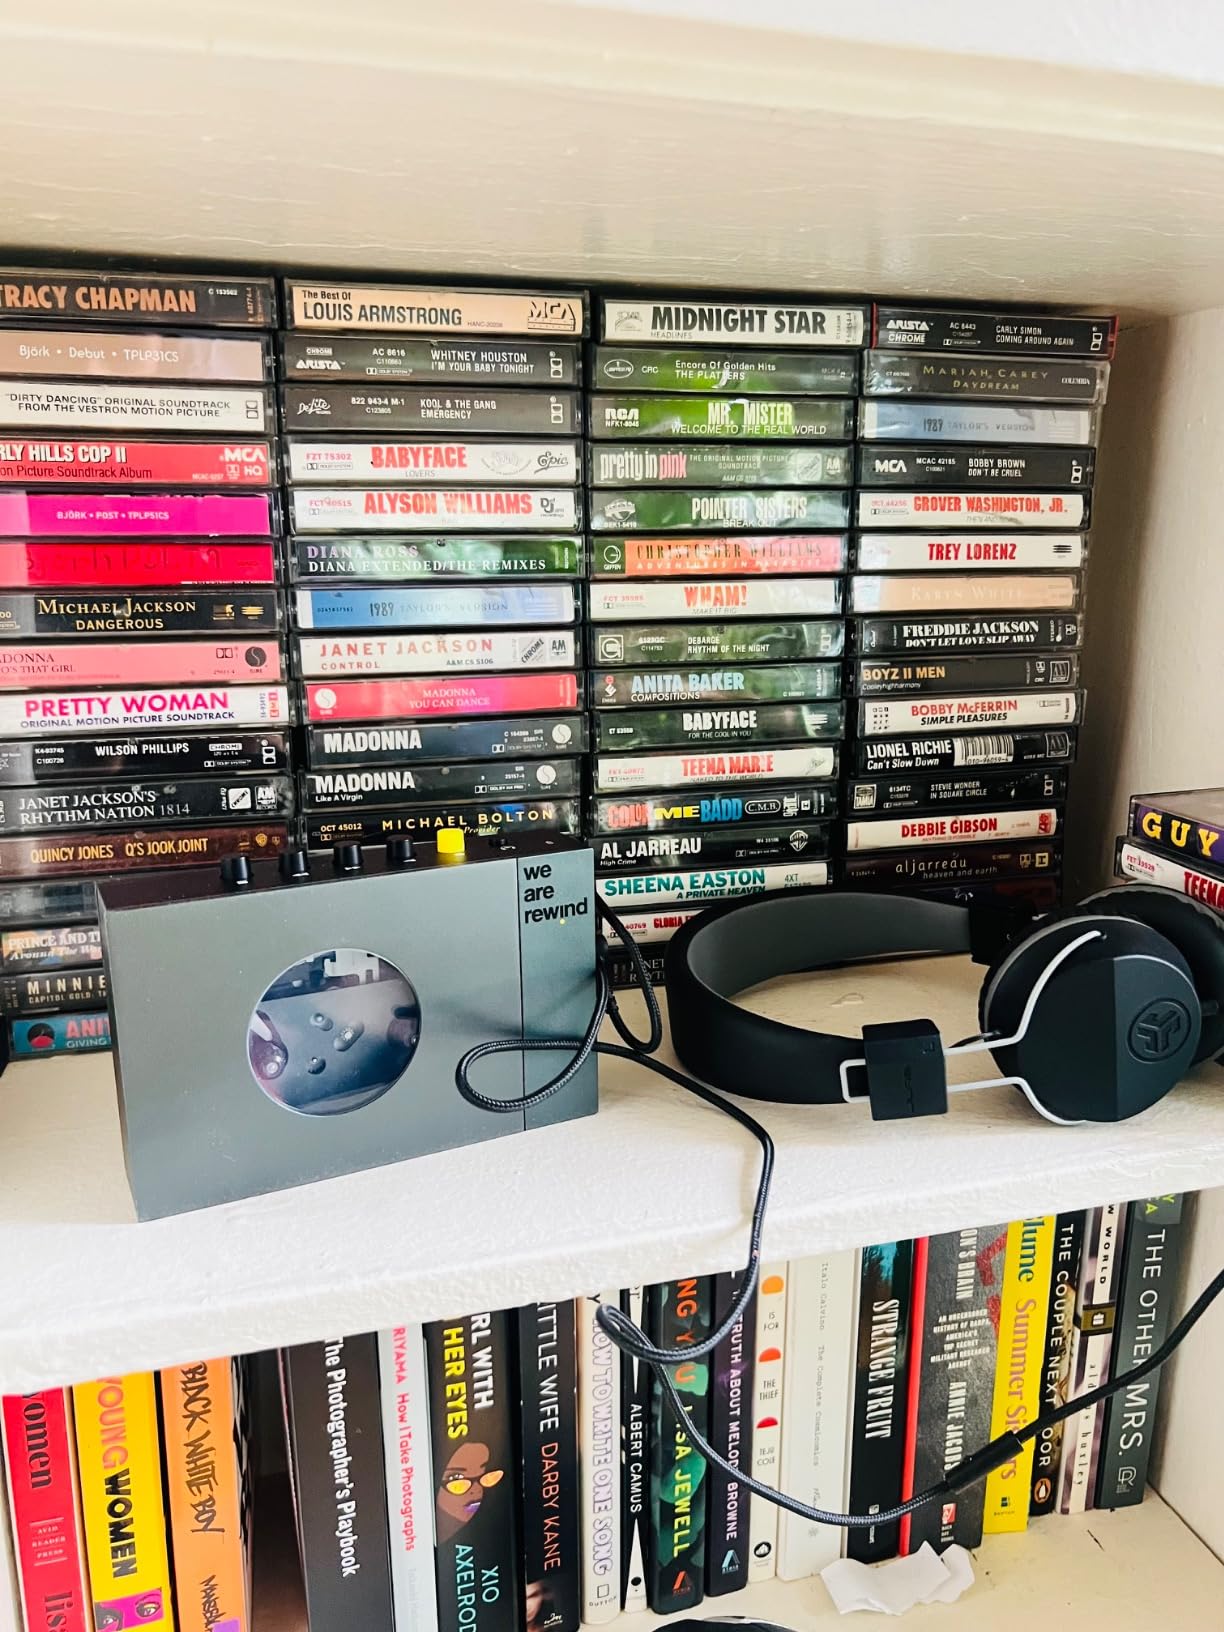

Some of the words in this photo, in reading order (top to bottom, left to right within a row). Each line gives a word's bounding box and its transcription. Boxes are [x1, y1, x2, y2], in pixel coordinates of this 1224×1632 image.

[75, 286, 196, 312] CHAPMAN
[303, 290, 317, 299] The
[321, 291, 339, 300] Best
[341, 292, 351, 300] Of
[303, 302, 353, 321] LOUIS
[358, 305, 462, 326] ARMSTRONG
[651, 306, 768, 333] MIDNIGHT
[774, 310, 826, 334] STAR
[996, 325, 1018, 334] CARLY
[1021, 326, 1042, 335] SIMON
[19, 344, 50, 358] Björk
[69, 347, 105, 359] Debut
[431, 350, 477, 361] WHITNEY
[481, 352, 527, 363] HOUSTON
[675, 360, 707, 369] Encore
[710, 361, 720, 370] Of
[723, 362, 755, 371] Golden
[758, 363, 776, 371] Hits
[923, 366, 988, 377] MARIAH
[998, 368, 1048, 379] CAREY
[953, 380, 1019, 390] DAYDREAM
[18, 403, 51, 412] FROM
[54, 404, 75, 413] THE
[78, 405, 128, 415] VESTRON
[131, 407, 173, 416] MOTION
[176, 408, 220, 417] PICTURE
[104, 396, 157, 407] ORIGINAL
[159, 399, 231, 409] SOUNDTRACK
[421, 409, 472, 420] EMERGENCY
[605, 408, 639, 420] RCA
[708, 402, 734, 425] MR.
[743, 402, 793, 426] MISTER
[224, 447, 266, 462] MCA
[371, 447, 468, 468] BABYFACE
[968, 458, 994, 468] BOBBY
[998, 459, 1025, 469] BROWN
[17, 465, 54, 478] Picture
[57, 465, 117, 479] Soundtrack
[119, 467, 152, 480] Album
[875, 459, 907, 473] MCA
[364, 492, 437, 514] ALYSON
[443, 492, 533, 514] WILLIAMS
[692, 498, 750, 520] POINTER
[755, 497, 807, 519] SISTERS
[913, 496, 961, 512] GROVER
[965, 497, 1045, 513] WASHINGTON,
[1049, 498, 1067, 512] JR.
[928, 544, 961, 561] TREY
[966, 543, 1017, 560] LORENZ
[309, 561, 356, 573] DIANA
[482, 559, 546, 571] REMIXES
[38, 599, 118, 615] MICHAEL
[124, 597, 196, 616] JACKSON
[684, 585, 747, 608] WHAM!
[369, 602, 394, 618] 1989
[76, 618, 164, 630] DANGEROUS
[903, 623, 970, 638] FREDDIE
[972, 620, 1039, 635] JACKSON
[320, 642, 388, 658] JANET
[396, 639, 493, 656] JACKSON
[321, 661, 381, 671] CONTROL
[863, 668, 899, 682] BOYZ
[903, 668, 911, 680] II
[915, 666, 945, 679] MEN
[631, 674, 685, 693] ANITA
[688, 672, 744, 691] BAKER
[24, 697, 111, 718] PRETTY
[121, 692, 228, 714] WOMAN
[631, 691, 700, 702] COMPOSITIONS
[911, 703, 953, 716] BOBBY
[957, 700, 1018, 714] McFERRIN
[20, 718, 73, 729] ORIGINAL
[76, 716, 119, 726] MOTION
[123, 714, 163, 723] PICTURE
[166, 711, 234, 722] SOUNDTRACK
[682, 710, 757, 731] BABYFACE
[921, 715, 954, 726] SIMPLE
[956, 712, 1008, 724] PLEASURES
[95, 744, 137, 755] WILSON
[143, 742, 189, 754] PHILLIPS
[324, 729, 422, 753] MADONNA
[866, 742, 909, 759] LIONEL
[912, 739, 952, 755] RICHIE
[681, 757, 726, 776] TEENA
[314, 771, 416, 793] MADONNA
[19, 797, 70, 810] JANET
[73, 791, 156, 806] JACKSON'S
[315, 795, 332, 803] Like
[333, 794, 340, 802] A
[341, 793, 363, 803] Virgin
[21, 809, 90, 825] RHYTHM
[95, 806, 155, 820] NATION
[160, 804, 190, 816] 1814
[382, 815, 468, 832] MICHAEL
[478, 809, 554, 824] BOLTON
[654, 806, 700, 820] ME
[700, 798, 742, 822] BADD
[902, 821, 946, 838] DEBBIE
[950, 818, 997, 834] GIBSON
[1142, 812, 1219, 857] GUY
[31, 847, 73, 864] QUINCY
[78, 844, 114, 860] JONES
[601, 842, 623, 860] AL
[626, 838, 702, 858] JARREAU
[524, 864, 552, 880] we
[524, 885, 554, 902] are
[604, 875, 684, 897] SHEENA
[690, 869, 765, 889] EASTON
[525, 897, 588, 924] rewind
[27, 975, 105, 995] MINNIE
[1058, 1223, 1074, 1262] THE
[1099, 1226, 1113, 1285] WORLD
[1143, 1229, 1165, 1280] THE
[768, 1312, 775, 1320] IS
[1052, 1270, 1069, 1354] COUPLE
[763, 1322, 779, 1331] FOR
[868, 1298, 900, 1382] STRANGE
[1006, 1298, 1037, 1401] Summer
[442, 1327, 465, 1378] HER
[472, 1345, 495, 1410] WITH
[763, 1379, 776, 1389] THE
[1045, 1356, 1062, 1404] NEXT
[538, 1374, 560, 1434] WIFE
[728, 1370, 741, 1422] ABOUT
[759, 1388, 779, 1401] THIEF
[397, 1393, 409, 1424] How
[446, 1381, 469, 1440] EYES
[865, 1384, 894, 1440] FRUIT
[1118, 1382, 1150, 1456] MRS.
[629, 1403, 642, 1456] ALBERT
[398, 1431, 411, 1464] Take
[759, 1447, 775, 1456] TEJU
[184, 1430, 219, 1497] WHITE
[757, 1456, 776, 1466] COLE
[541, 1442, 560, 1508] DARBY
[593, 1469, 613, 1514] ONE
[630, 1460, 642, 1514] CAMUS
[190, 1494, 225, 1533] BOY
[400, 1467, 417, 1552] Photographs
[673, 1467, 693, 1558] JEWELL
[726, 1482, 739, 1541] BROWNE
[104, 1468, 138, 1579] WOMEN
[544, 1514, 561, 1572] KANE
[592, 1517, 613, 1576] SONG
[481, 1565, 499, 1603] XIO
